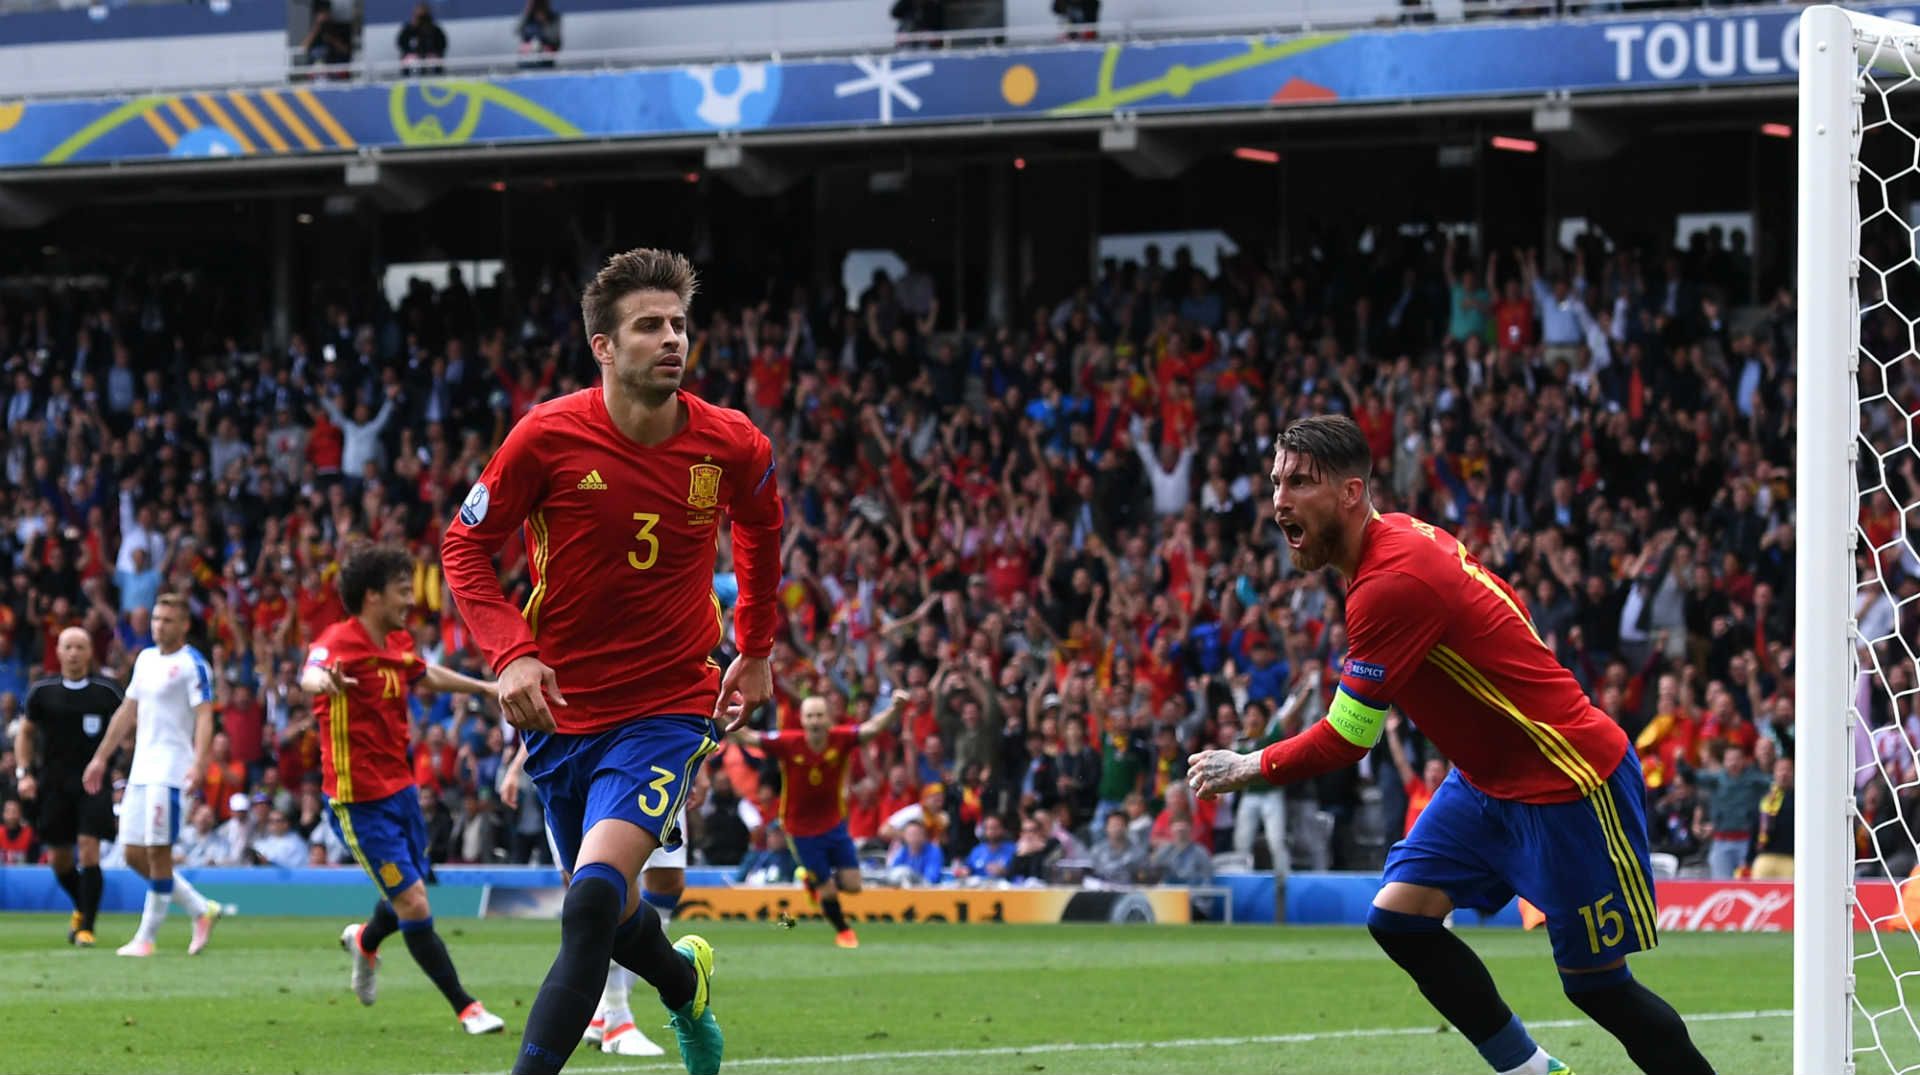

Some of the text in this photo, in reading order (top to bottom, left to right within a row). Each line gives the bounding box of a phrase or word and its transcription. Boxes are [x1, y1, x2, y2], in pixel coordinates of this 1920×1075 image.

[628, 513, 661, 570] 3
[377, 668, 400, 698] 21
[1352, 664, 1385, 677] RESPECT
[638, 765, 676, 817] 3
[1578, 892, 1625, 954] 15
